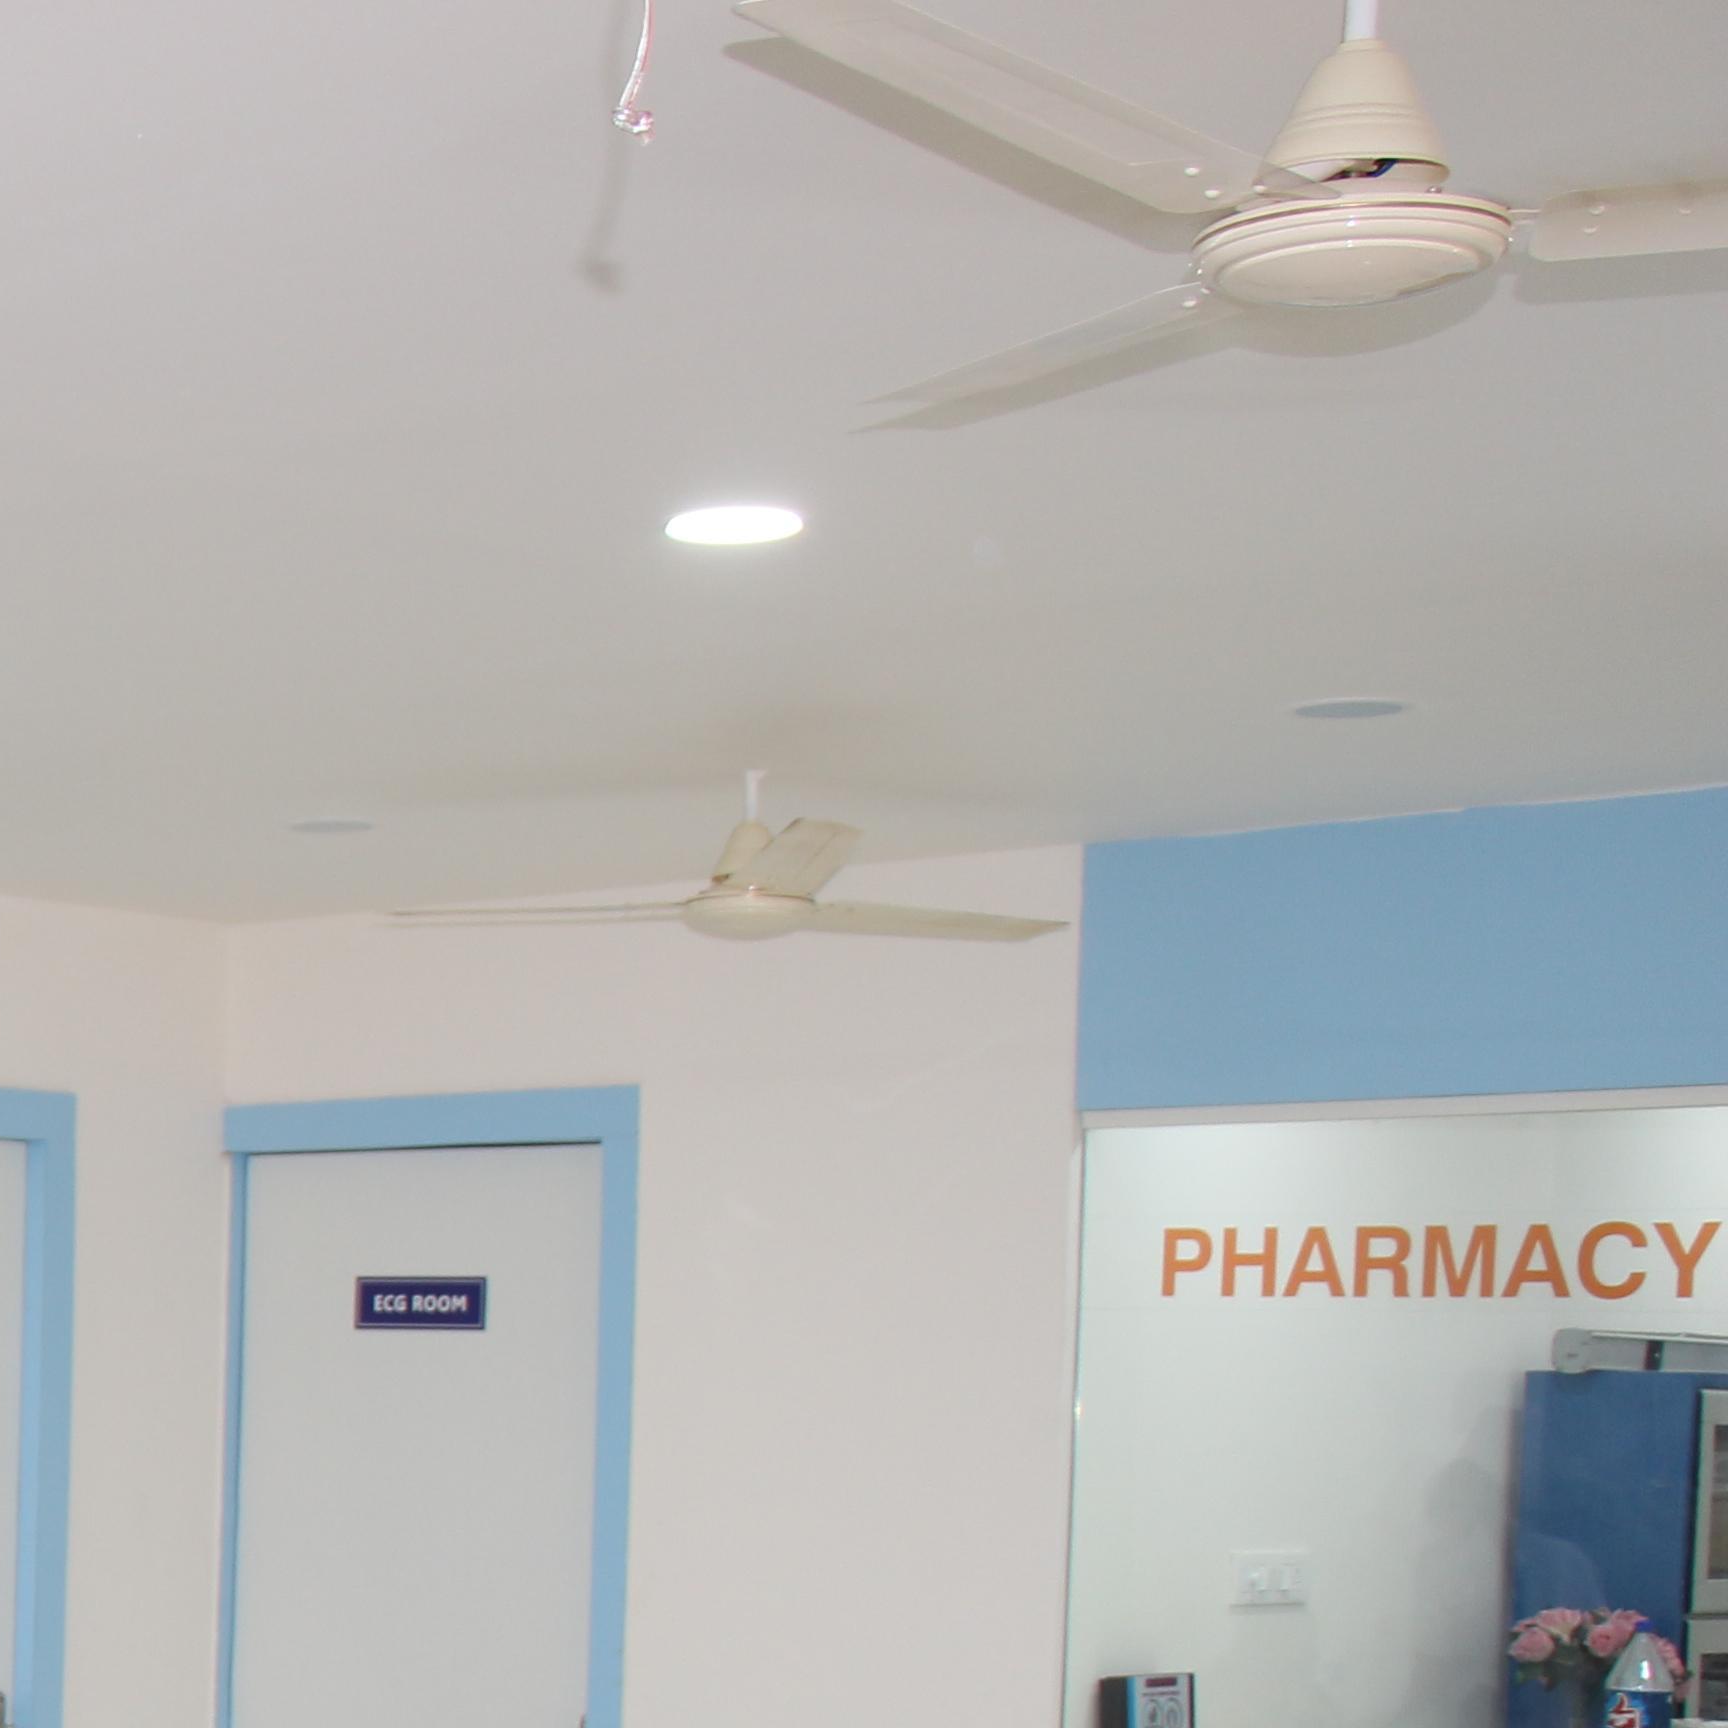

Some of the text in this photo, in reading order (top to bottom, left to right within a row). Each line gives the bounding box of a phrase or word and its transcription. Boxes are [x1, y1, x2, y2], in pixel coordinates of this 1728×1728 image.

[1160, 1220, 1723, 1300] PHARMACY
[372, 1294, 468, 1312] ECG ROOM
